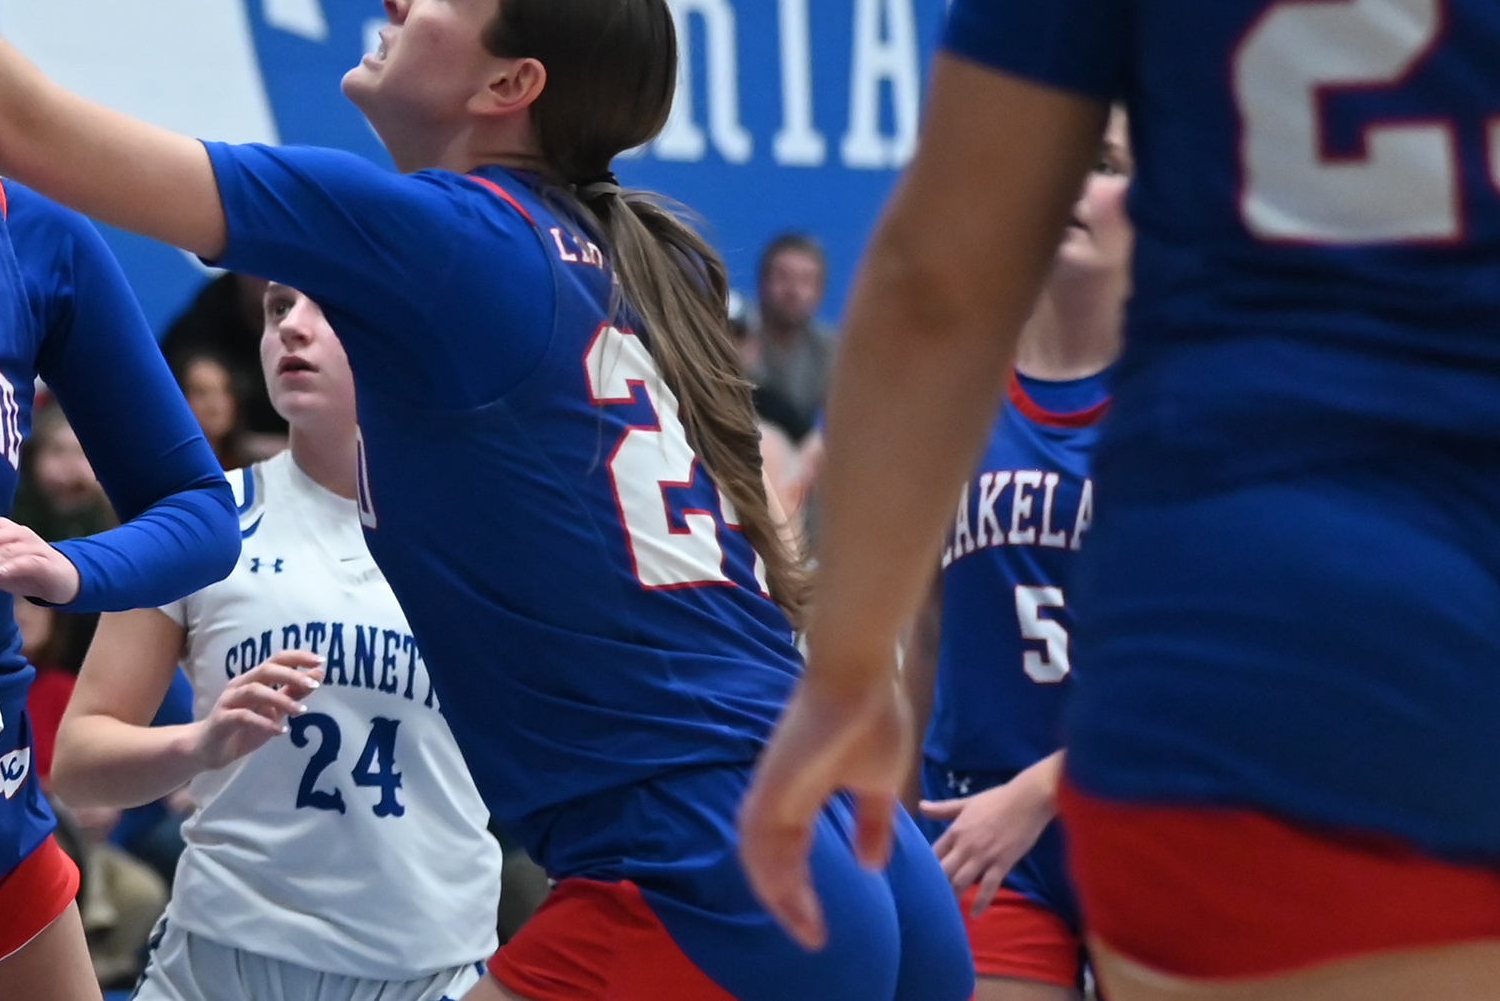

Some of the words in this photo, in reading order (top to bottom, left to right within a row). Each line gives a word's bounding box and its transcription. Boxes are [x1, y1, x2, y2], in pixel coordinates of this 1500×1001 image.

[583, 320, 771, 600] 2
[1015, 584, 1071, 684] 5
[288, 712, 406, 819] 24
